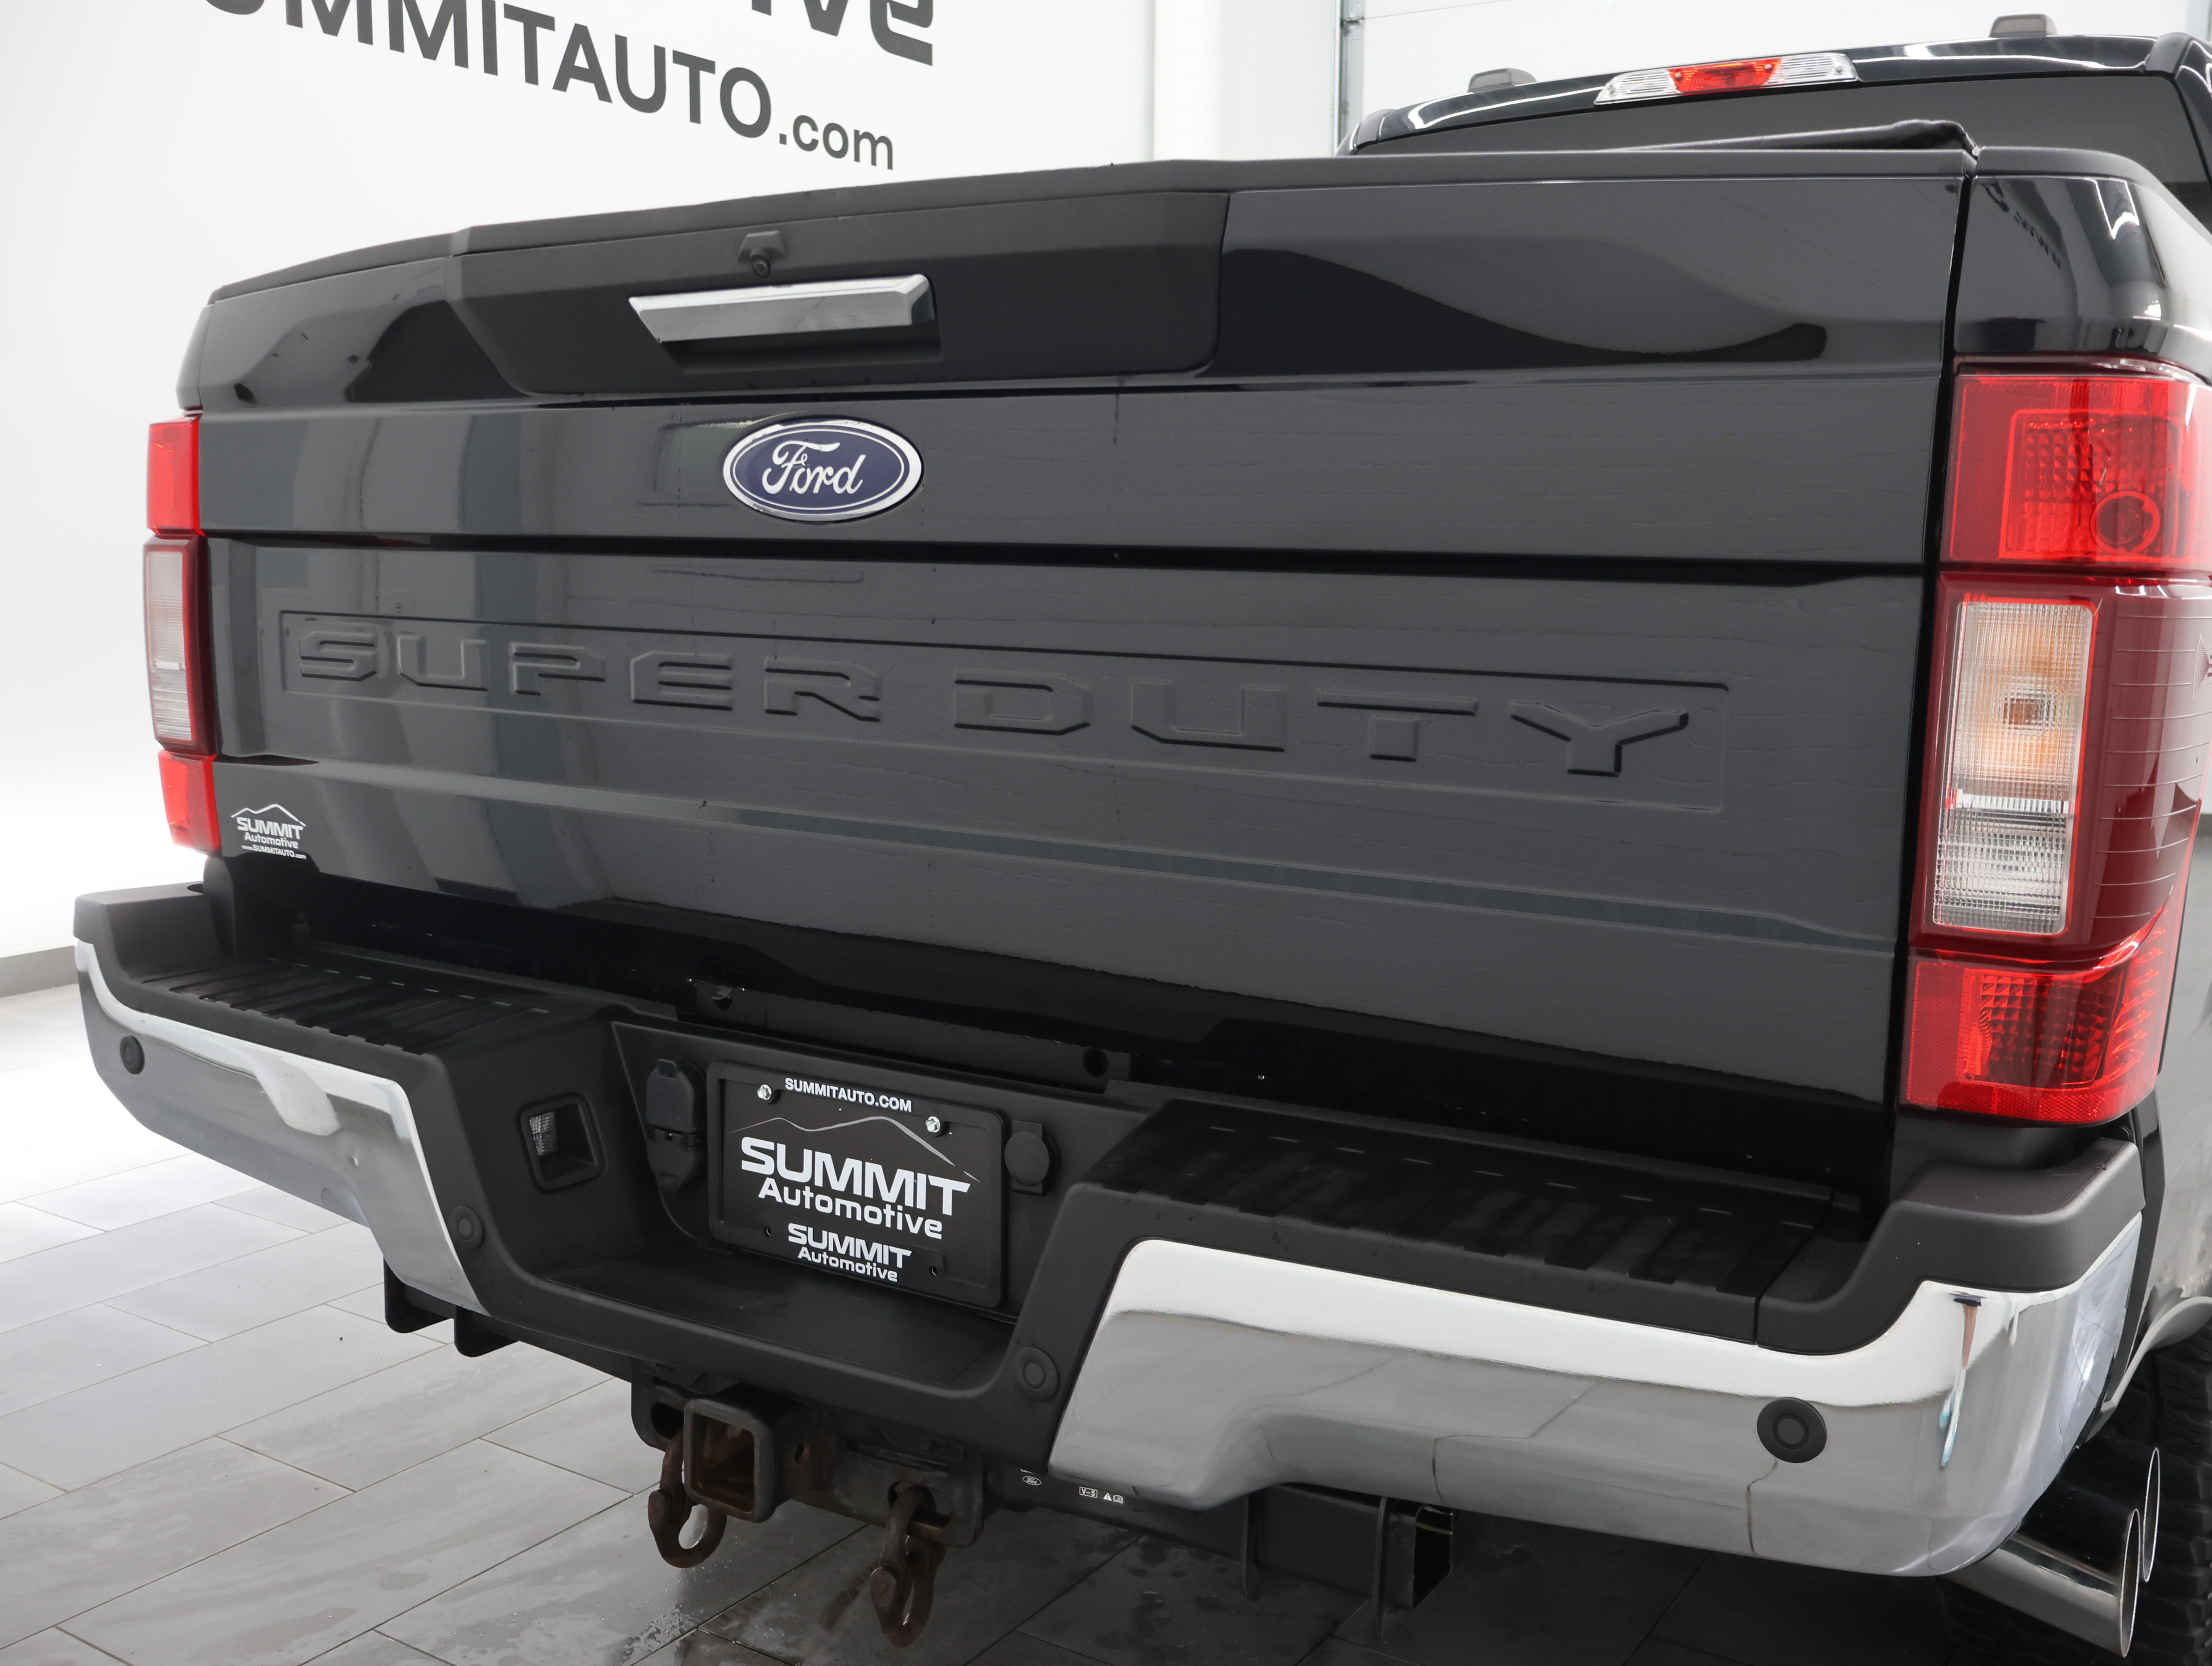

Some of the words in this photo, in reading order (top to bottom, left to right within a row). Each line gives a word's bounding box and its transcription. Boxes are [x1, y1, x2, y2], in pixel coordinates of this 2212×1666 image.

[762, 440, 866, 495] Ford
[299, 629, 882, 722] SUPER
[954, 669, 1689, 777] DUTY
[236, 816, 304, 840] SUMMIT
[244, 832, 299, 849] Automotive
[241, 844, 307, 859] www.SUMMITAUTO.com
[785, 1078, 913, 1113] SUMMITAUTO.COM
[741, 1137, 971, 1216] SUMMIT
[758, 1177, 943, 1240] Automotive
[788, 1223, 913, 1269] SUMMIT
[798, 1247, 898, 1283] Automotive
[1082, 1488, 1096, 1497] V-5
